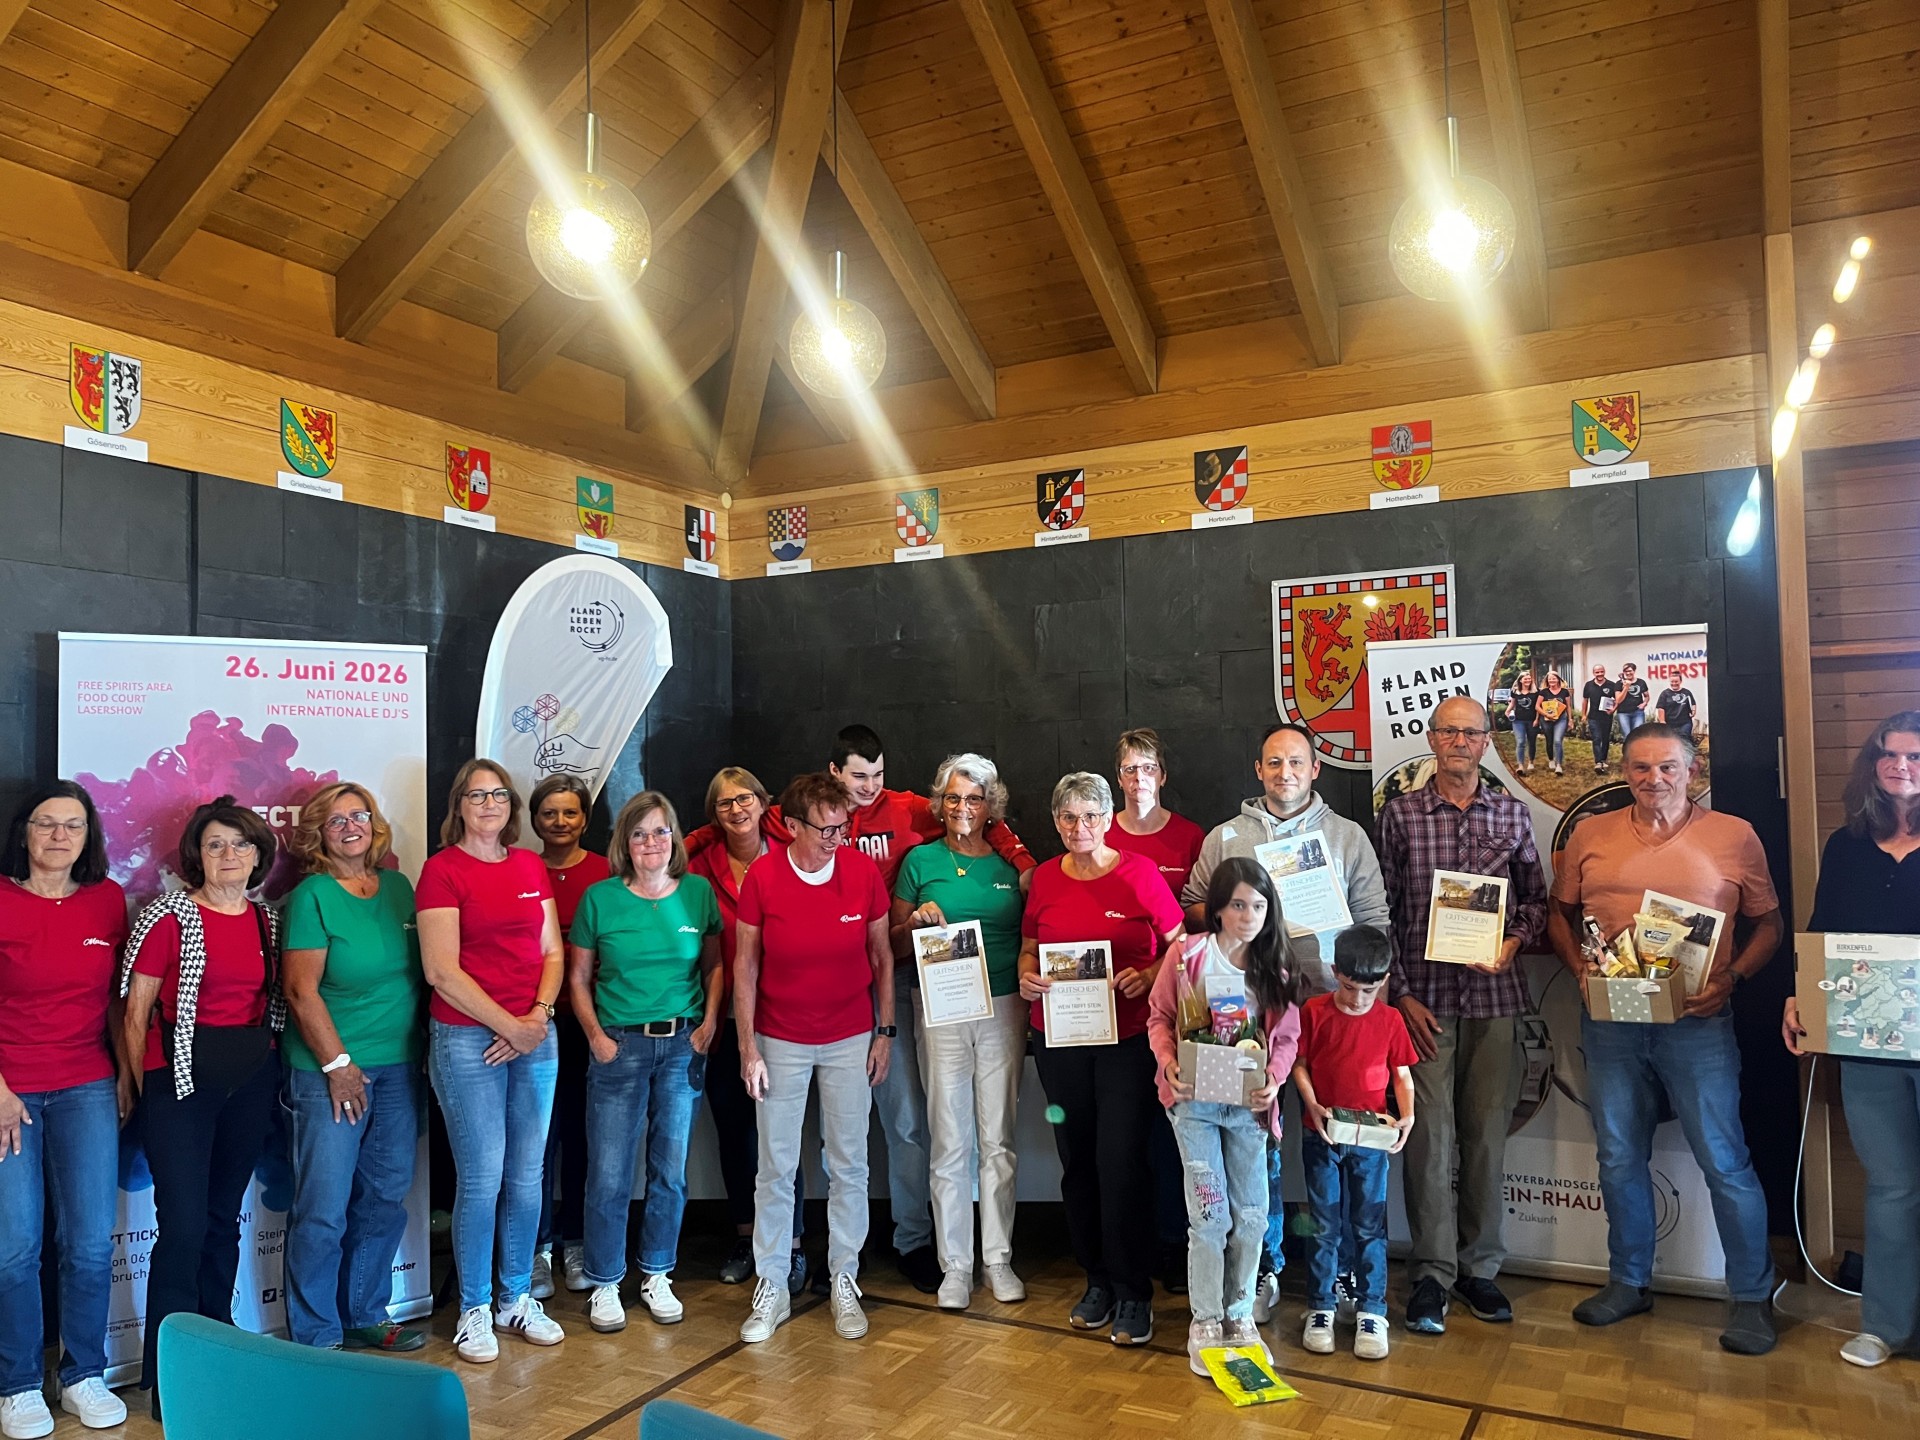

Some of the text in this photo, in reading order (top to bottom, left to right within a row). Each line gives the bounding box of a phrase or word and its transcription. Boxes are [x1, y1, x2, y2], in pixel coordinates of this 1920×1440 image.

[87, 437, 127, 451] Gösenroth
[1591, 470, 1627, 479] Kempfeld
[1385, 493, 1423, 502] Hottenbach
[1208, 515, 1236, 523] Horbruch
[571, 607, 602, 615] #LAND
[570, 616, 602, 625] LEBEN
[570, 626, 602, 634] ROCKT
[226, 656, 408, 684] 26. Juni 2026
[1381, 662, 1466, 693] #LAND
[77, 681, 173, 691] FREE SPIRITS AREA
[77, 693, 147, 703] FOOD COURT
[306, 689, 409, 703] NATIONALE UND
[77, 705, 143, 715] LASERSHOW
[267, 704, 409, 719] INTERNATIONALE DJ'S
[933, 963, 973, 975] GUTSCHEIN
[1058, 985, 1099, 993] GUTSCHEIN
[1518, 1212, 1558, 1225] Zukunft
[258, 1243, 283, 1256] Nied
